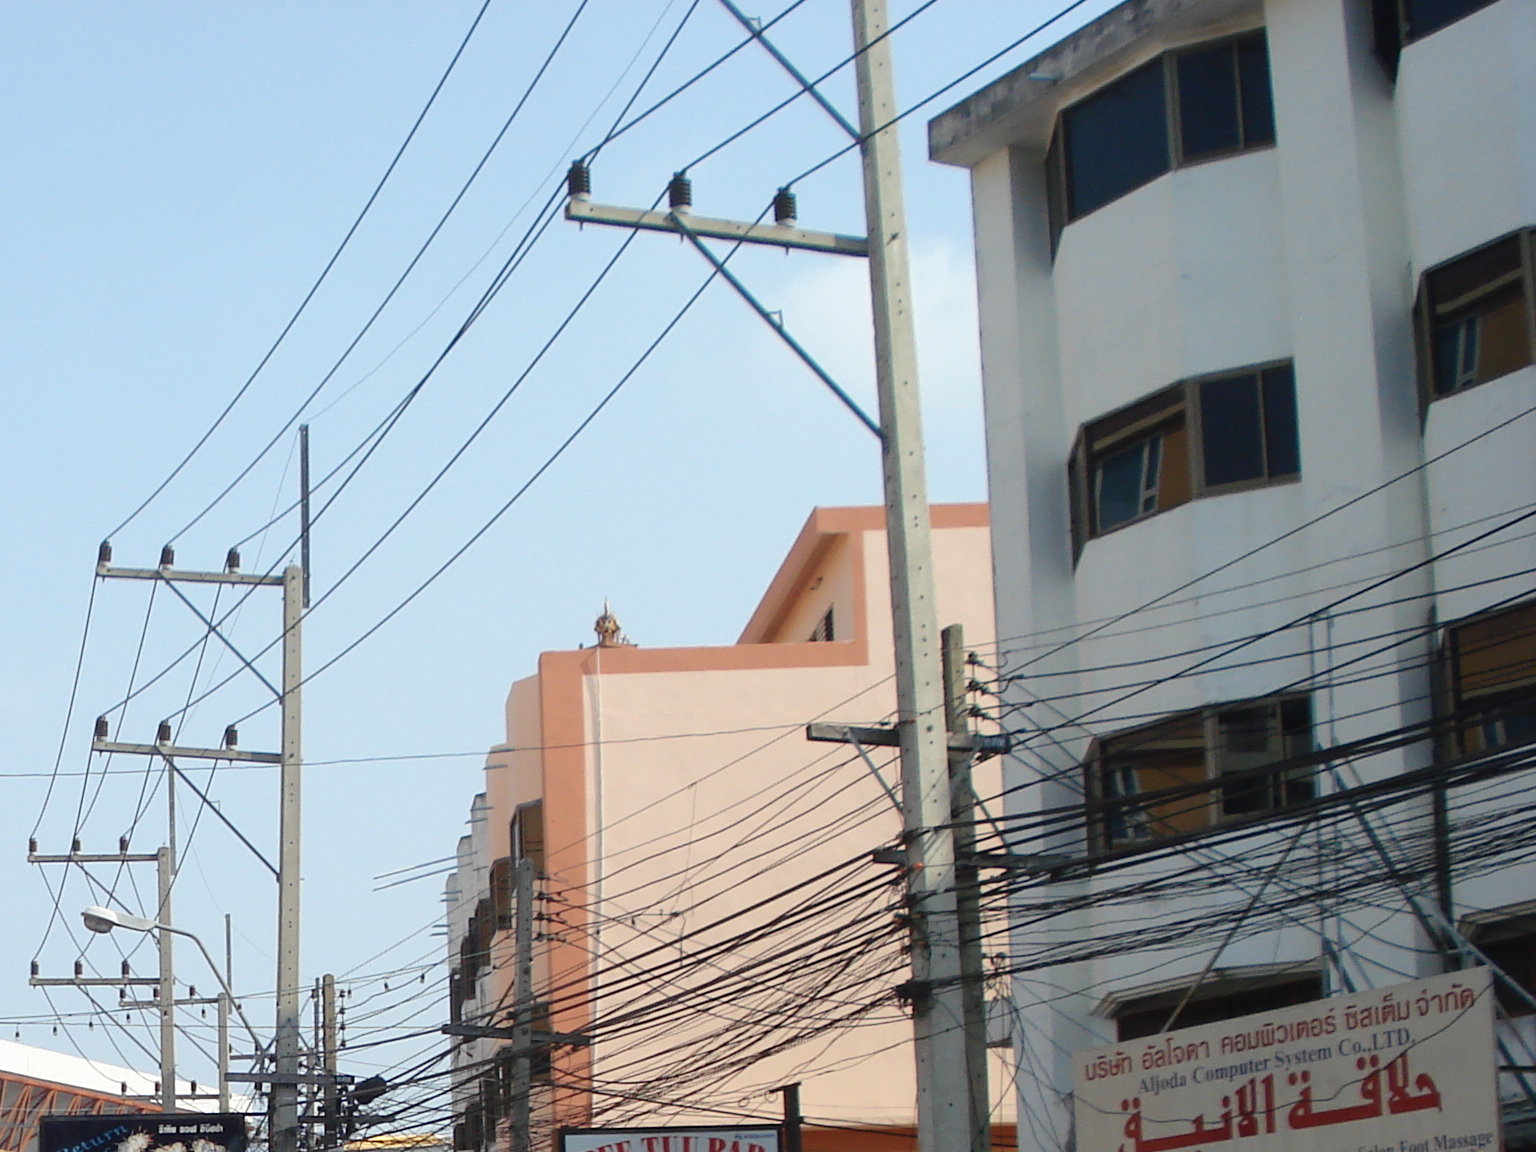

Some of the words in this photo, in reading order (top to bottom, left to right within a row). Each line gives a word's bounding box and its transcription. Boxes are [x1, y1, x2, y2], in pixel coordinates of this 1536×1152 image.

[1085, 1052, 1132, 1081] บริษัท
[1142, 1037, 1210, 1070] อัลโจดา
[1221, 1008, 1337, 1053] คอมพิวเตอร์
[1416, 983, 1475, 1017] จำกัด
[1139, 1071, 1186, 1096] Aljoda
[1193, 1056, 1270, 1083] Computer
[1275, 1046, 1332, 1071] System
[1289, 1053, 1442, 1130] حلاقة
[1434, 1131, 1493, 1152] Massage
